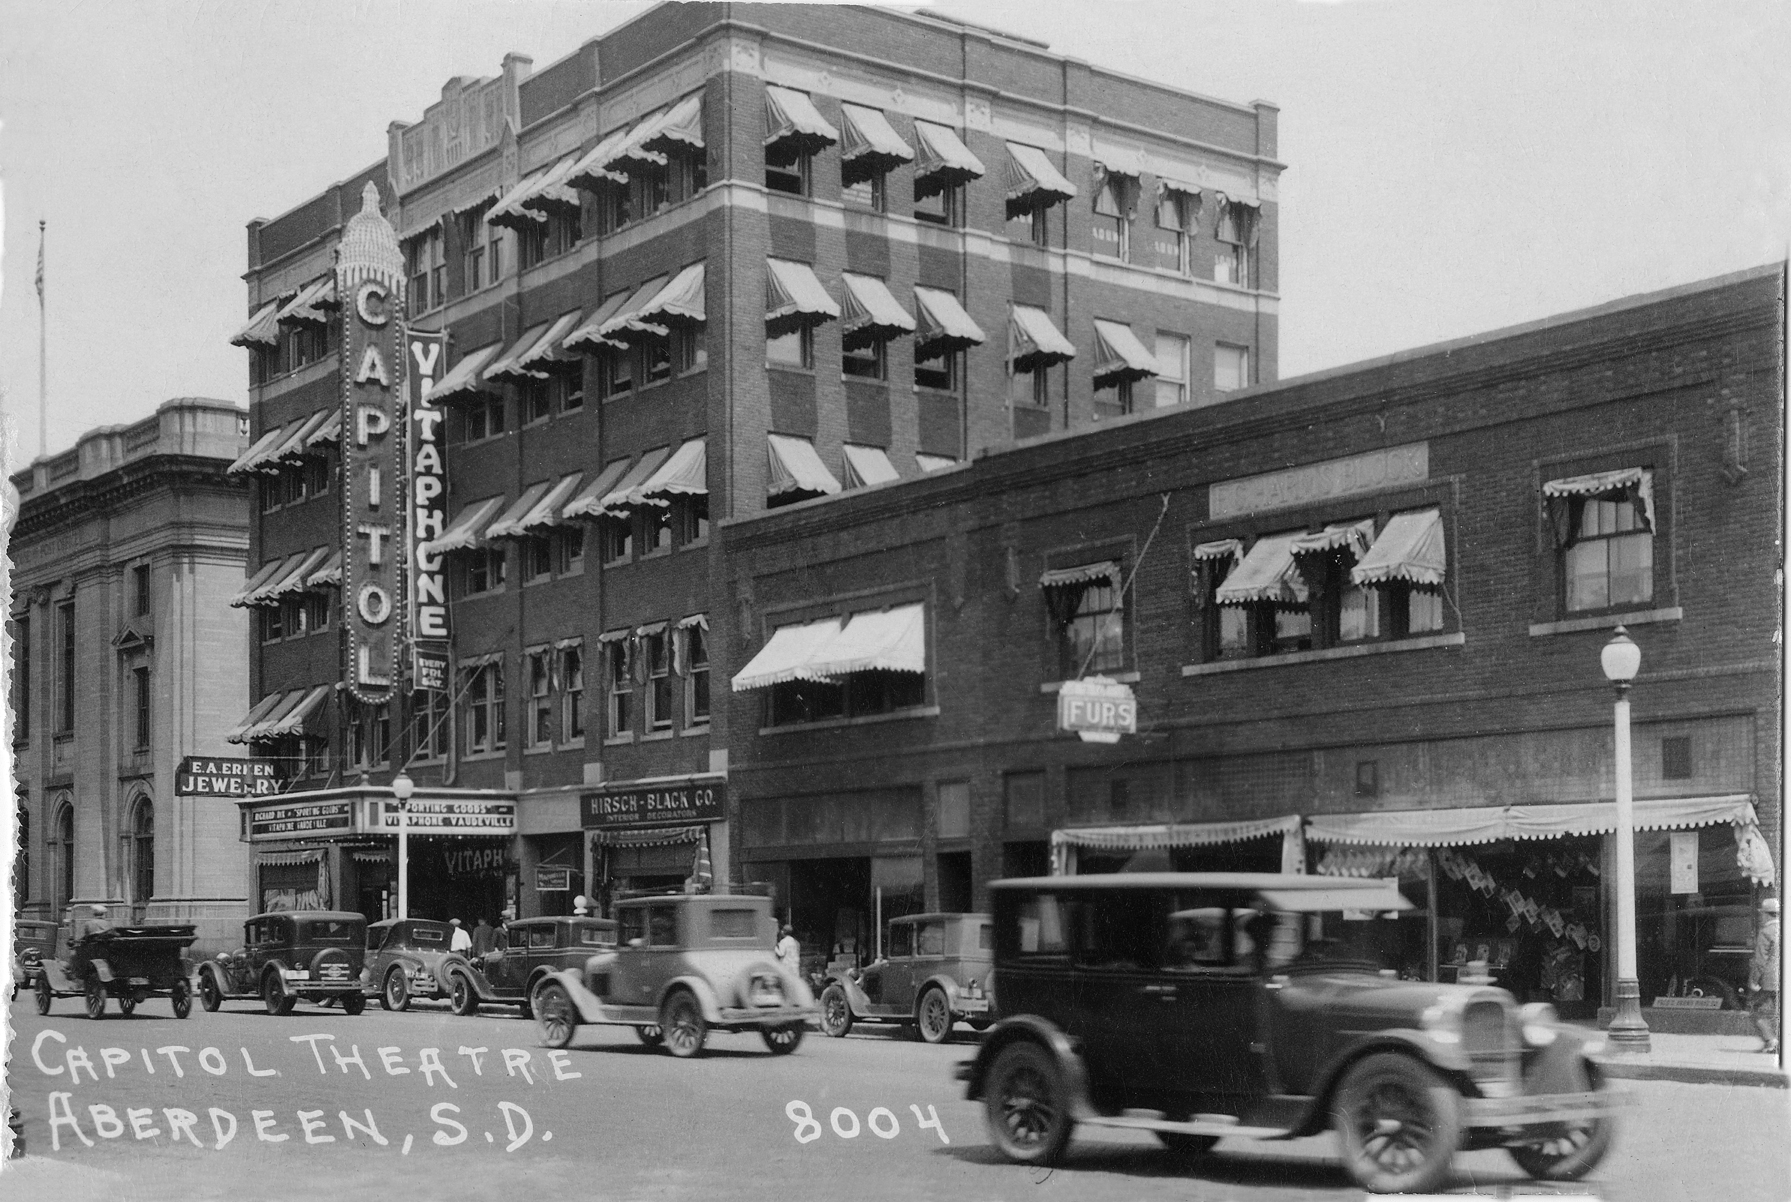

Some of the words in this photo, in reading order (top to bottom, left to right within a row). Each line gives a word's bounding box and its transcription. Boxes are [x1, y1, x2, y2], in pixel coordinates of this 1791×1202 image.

[355, 281, 393, 687] CAPITOL
[411, 341, 448, 636] VITAPHONE
[418, 657, 446, 668] EVERY
[421, 667, 444, 678] FRI.
[421, 677, 444, 687] SAT.
[1070, 701, 1131, 726] FURS
[695, 789, 716, 807] CO.
[646, 809, 697, 820] DECORATORS
[386, 816, 443, 826] VIAPHONE
[449, 816, 512, 827] VAUDEVILLE
